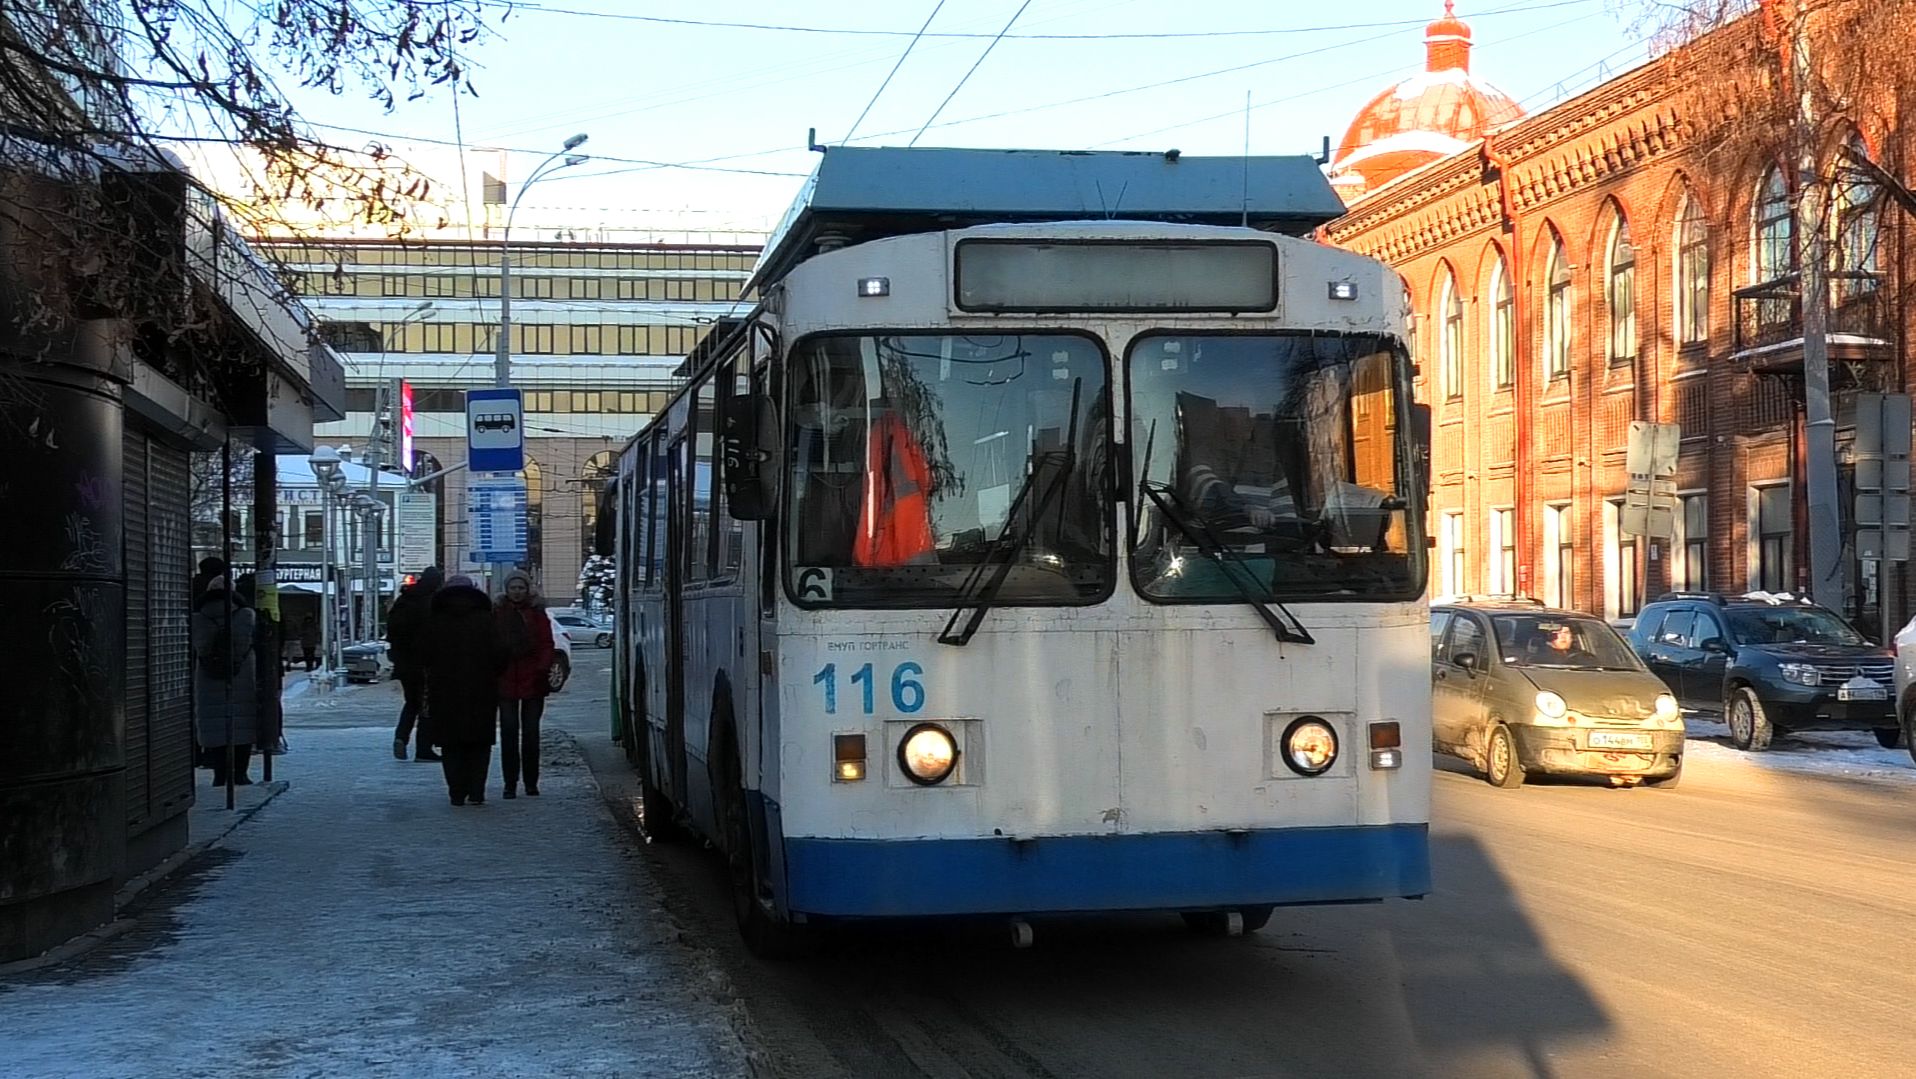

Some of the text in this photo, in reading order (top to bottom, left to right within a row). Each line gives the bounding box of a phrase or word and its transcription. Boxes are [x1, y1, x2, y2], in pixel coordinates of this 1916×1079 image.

[798, 568, 827, 598] 6
[859, 641, 909, 651] ГОРТРАНС
[813, 662, 925, 714] 116
